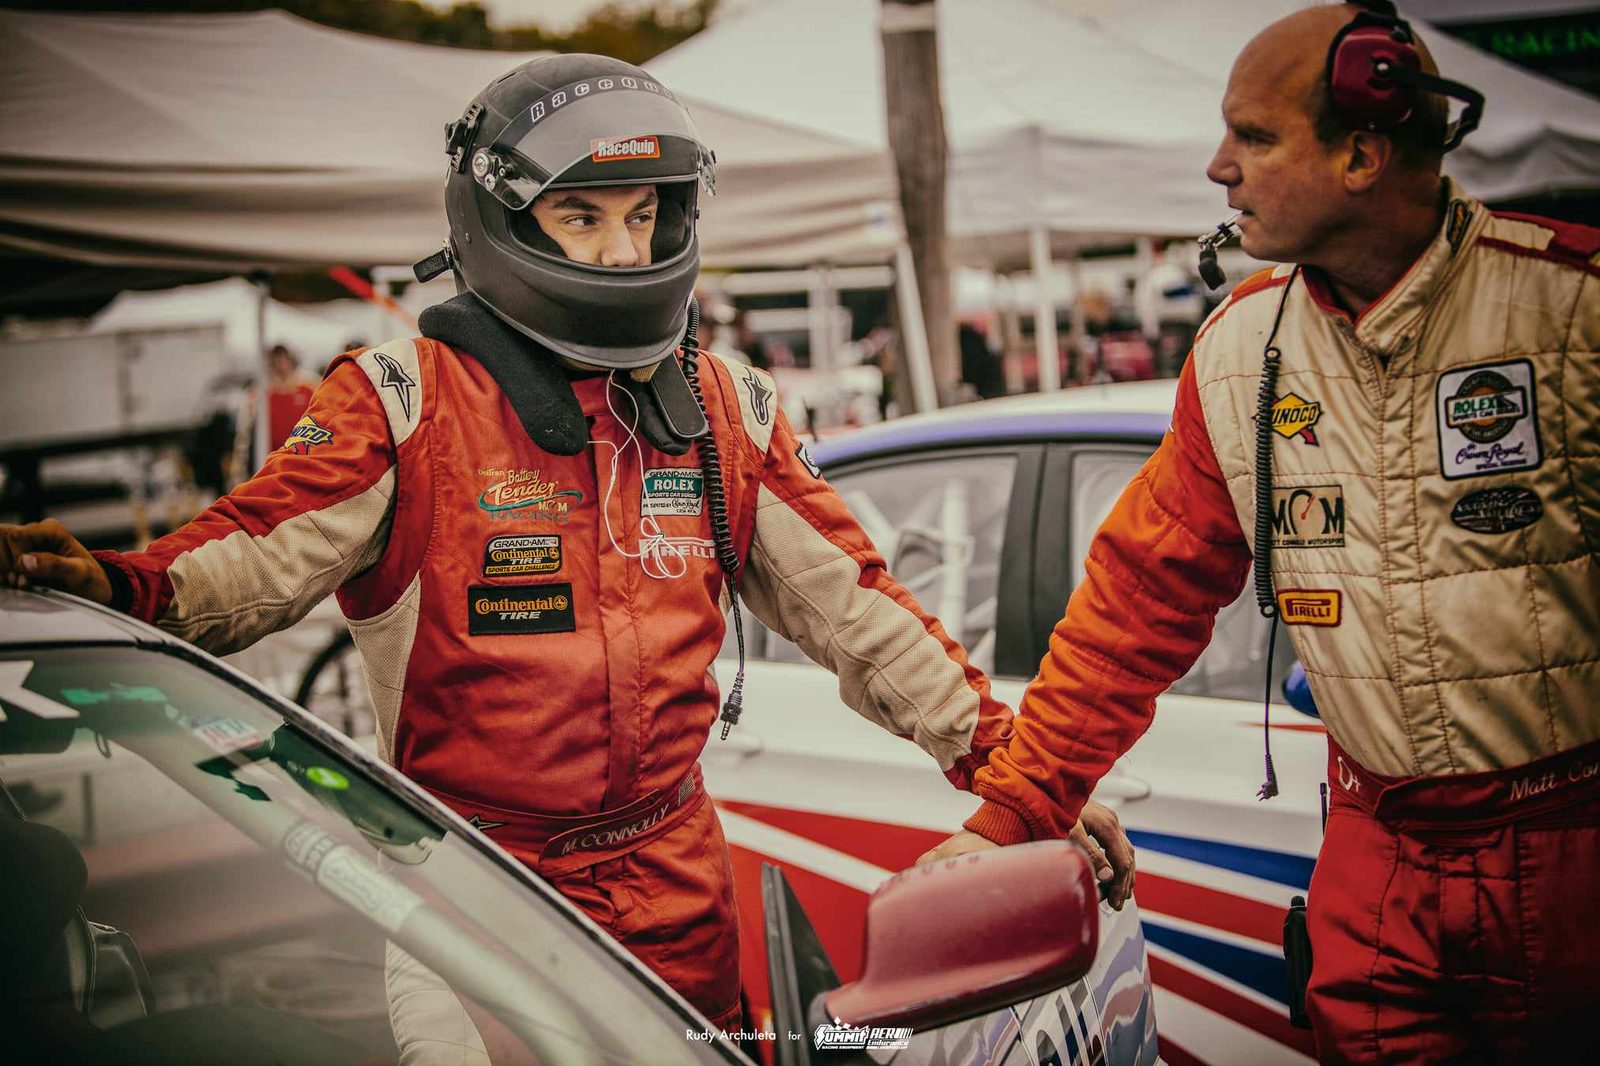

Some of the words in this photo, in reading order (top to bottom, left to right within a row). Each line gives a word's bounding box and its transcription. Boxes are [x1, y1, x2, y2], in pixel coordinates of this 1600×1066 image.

[597, 138, 655, 157] RaceQuip
[1271, 404, 1317, 425] UNOCO
[1454, 397, 1497, 415] ROLEX
[487, 481, 556, 506] Tender
[653, 479, 694, 491] ROLEX
[491, 547, 549, 562] Continental
[475, 597, 555, 615] Continental
[499, 611, 542, 620] TIRE
[1285, 599, 1332, 618] PIRELLI
[1506, 773, 1558, 803] Matt
[581, 803, 670, 848] CONNOLLY
